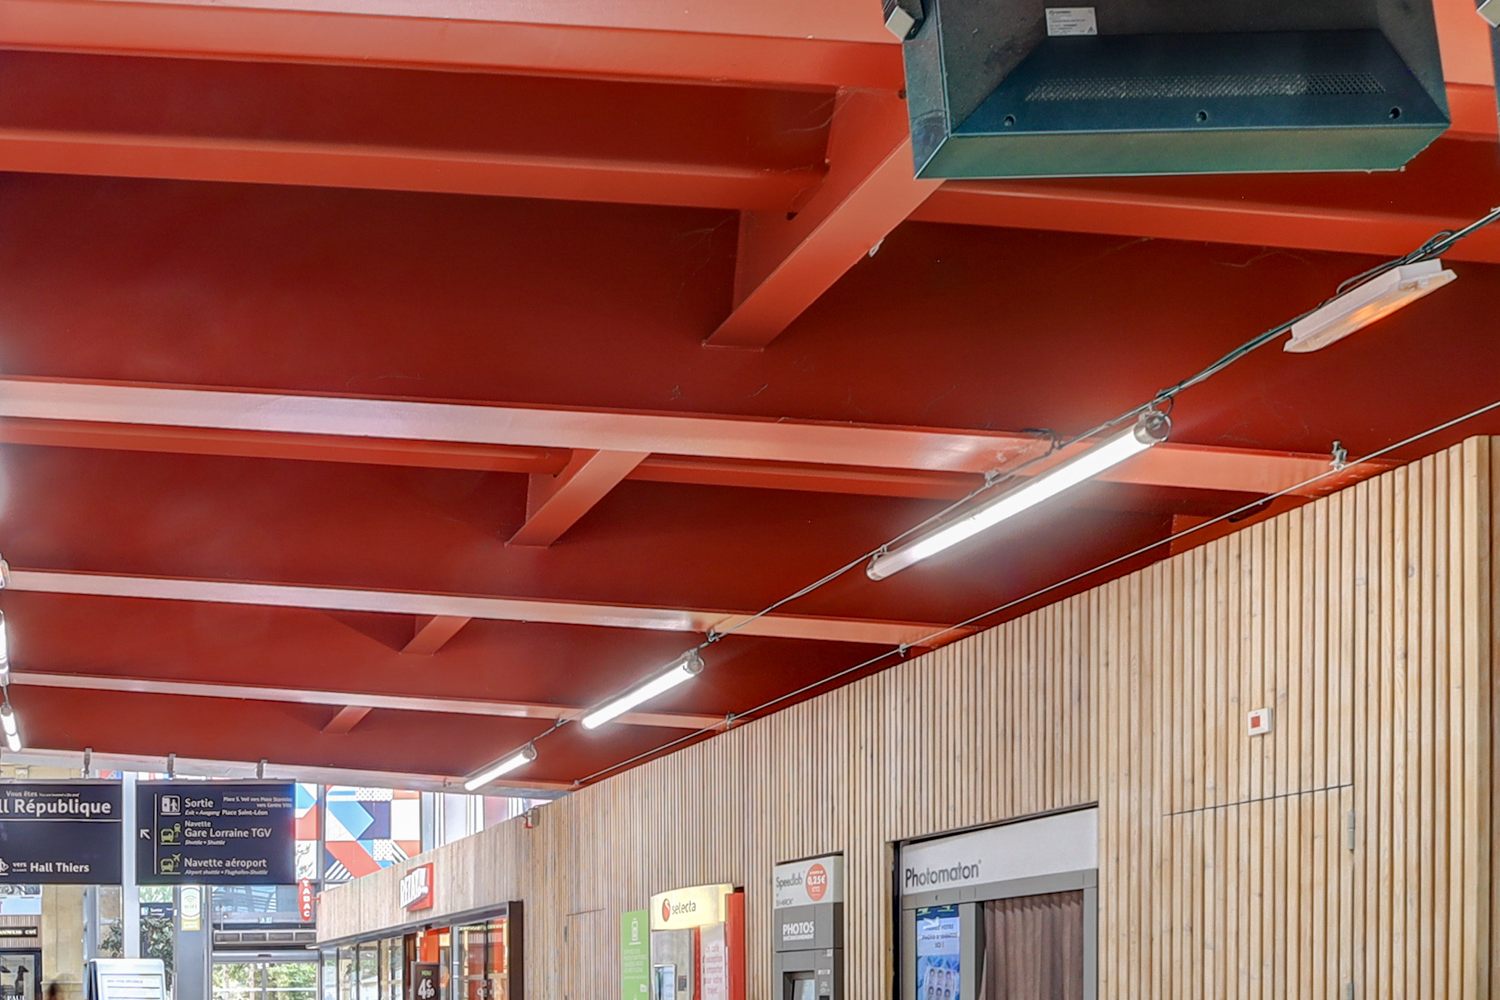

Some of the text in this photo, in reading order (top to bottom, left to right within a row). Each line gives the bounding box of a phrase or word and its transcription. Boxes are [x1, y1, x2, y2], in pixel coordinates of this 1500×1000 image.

[14, 799, 111, 817] République
[185, 798, 214, 808] Sortie
[185, 828, 272, 838] Gare Lorraine TGV
[30, 862, 90, 873] Hall Thiers
[184, 857, 267, 869] Navette aéroport
[776, 873, 803, 891] Speedlab
[807, 875, 826, 885] 0,25€
[905, 862, 979, 888] Photomaton
[302, 879, 311, 917] TABAC
[672, 901, 697, 915] selecta
[783, 921, 815, 935] PHOTOS
